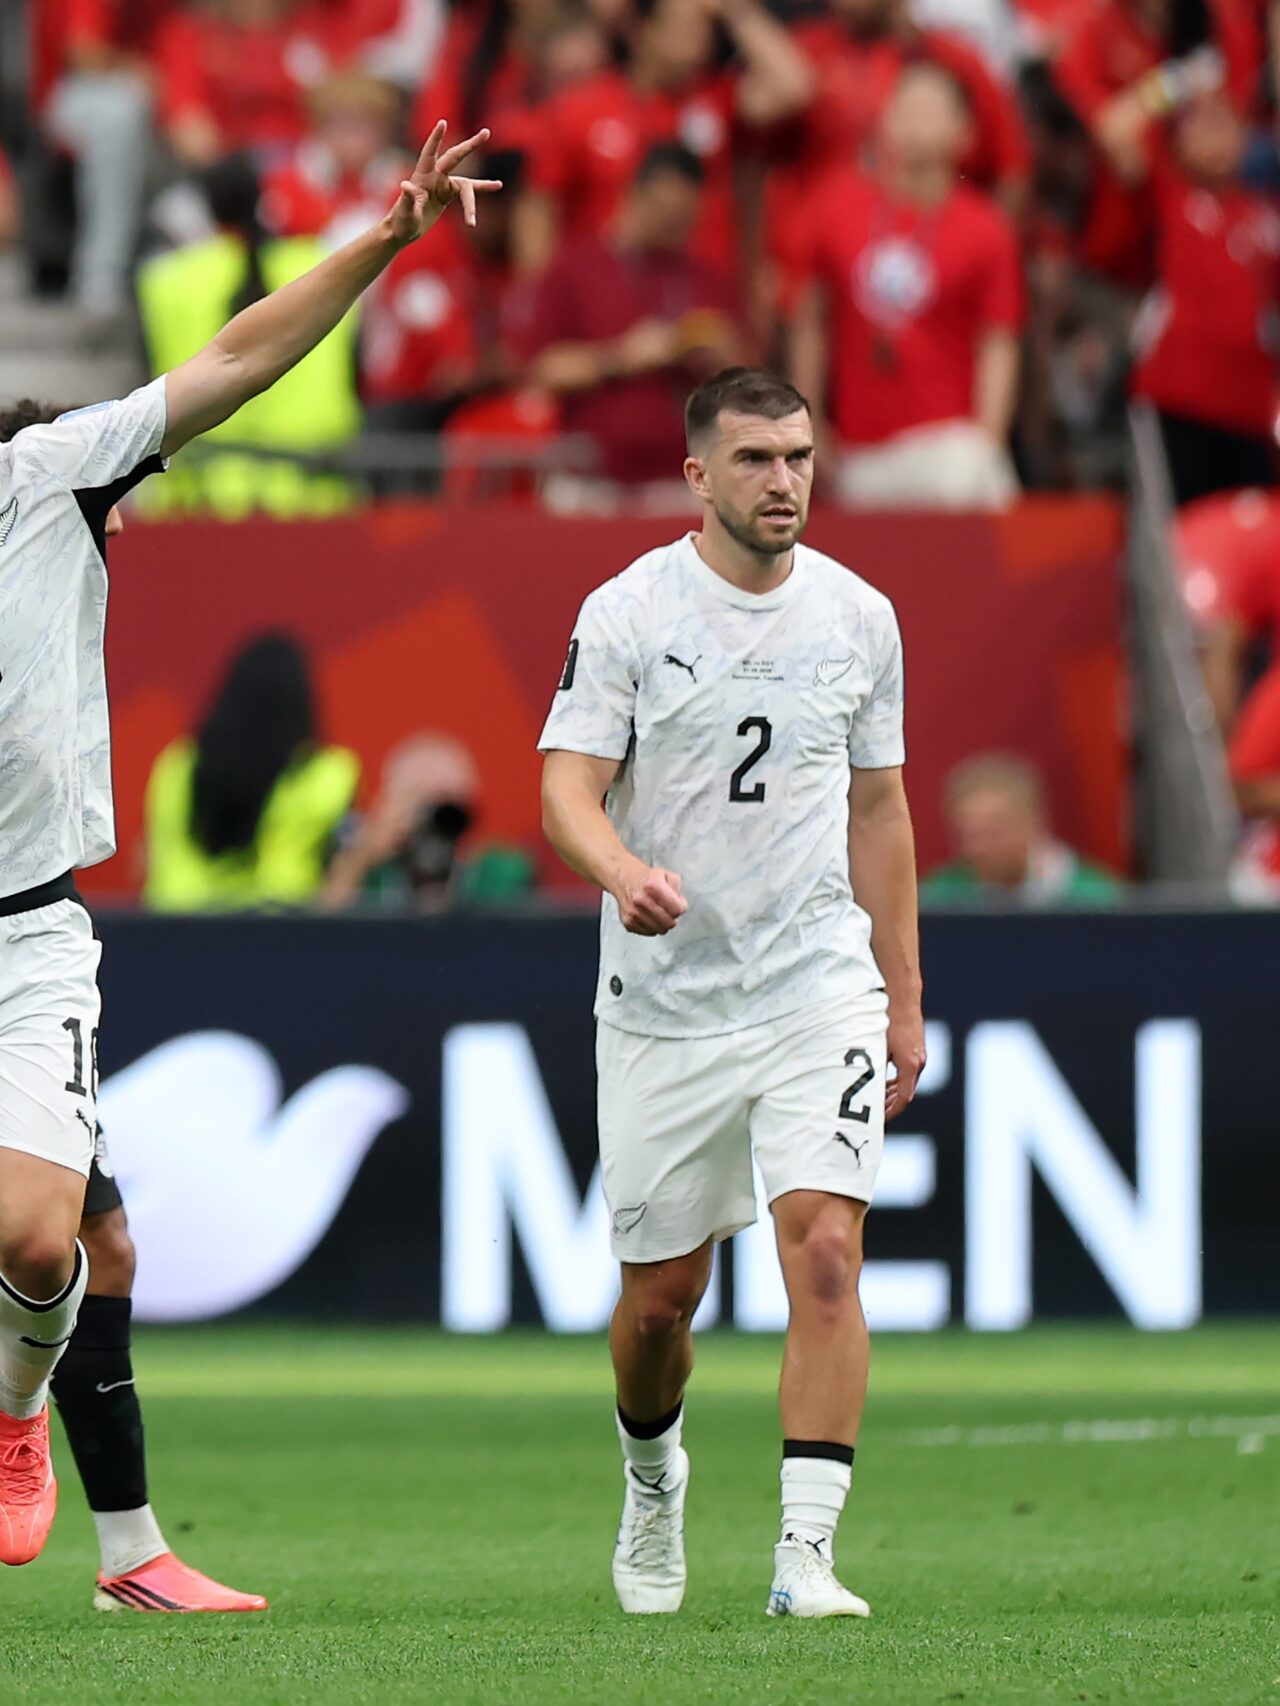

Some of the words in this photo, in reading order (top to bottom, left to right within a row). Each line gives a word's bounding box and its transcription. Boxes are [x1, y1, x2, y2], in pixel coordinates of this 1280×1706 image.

[728, 716, 772, 802] 2
[61, 1016, 97, 1104] 1
[838, 1048, 875, 1124] 2
